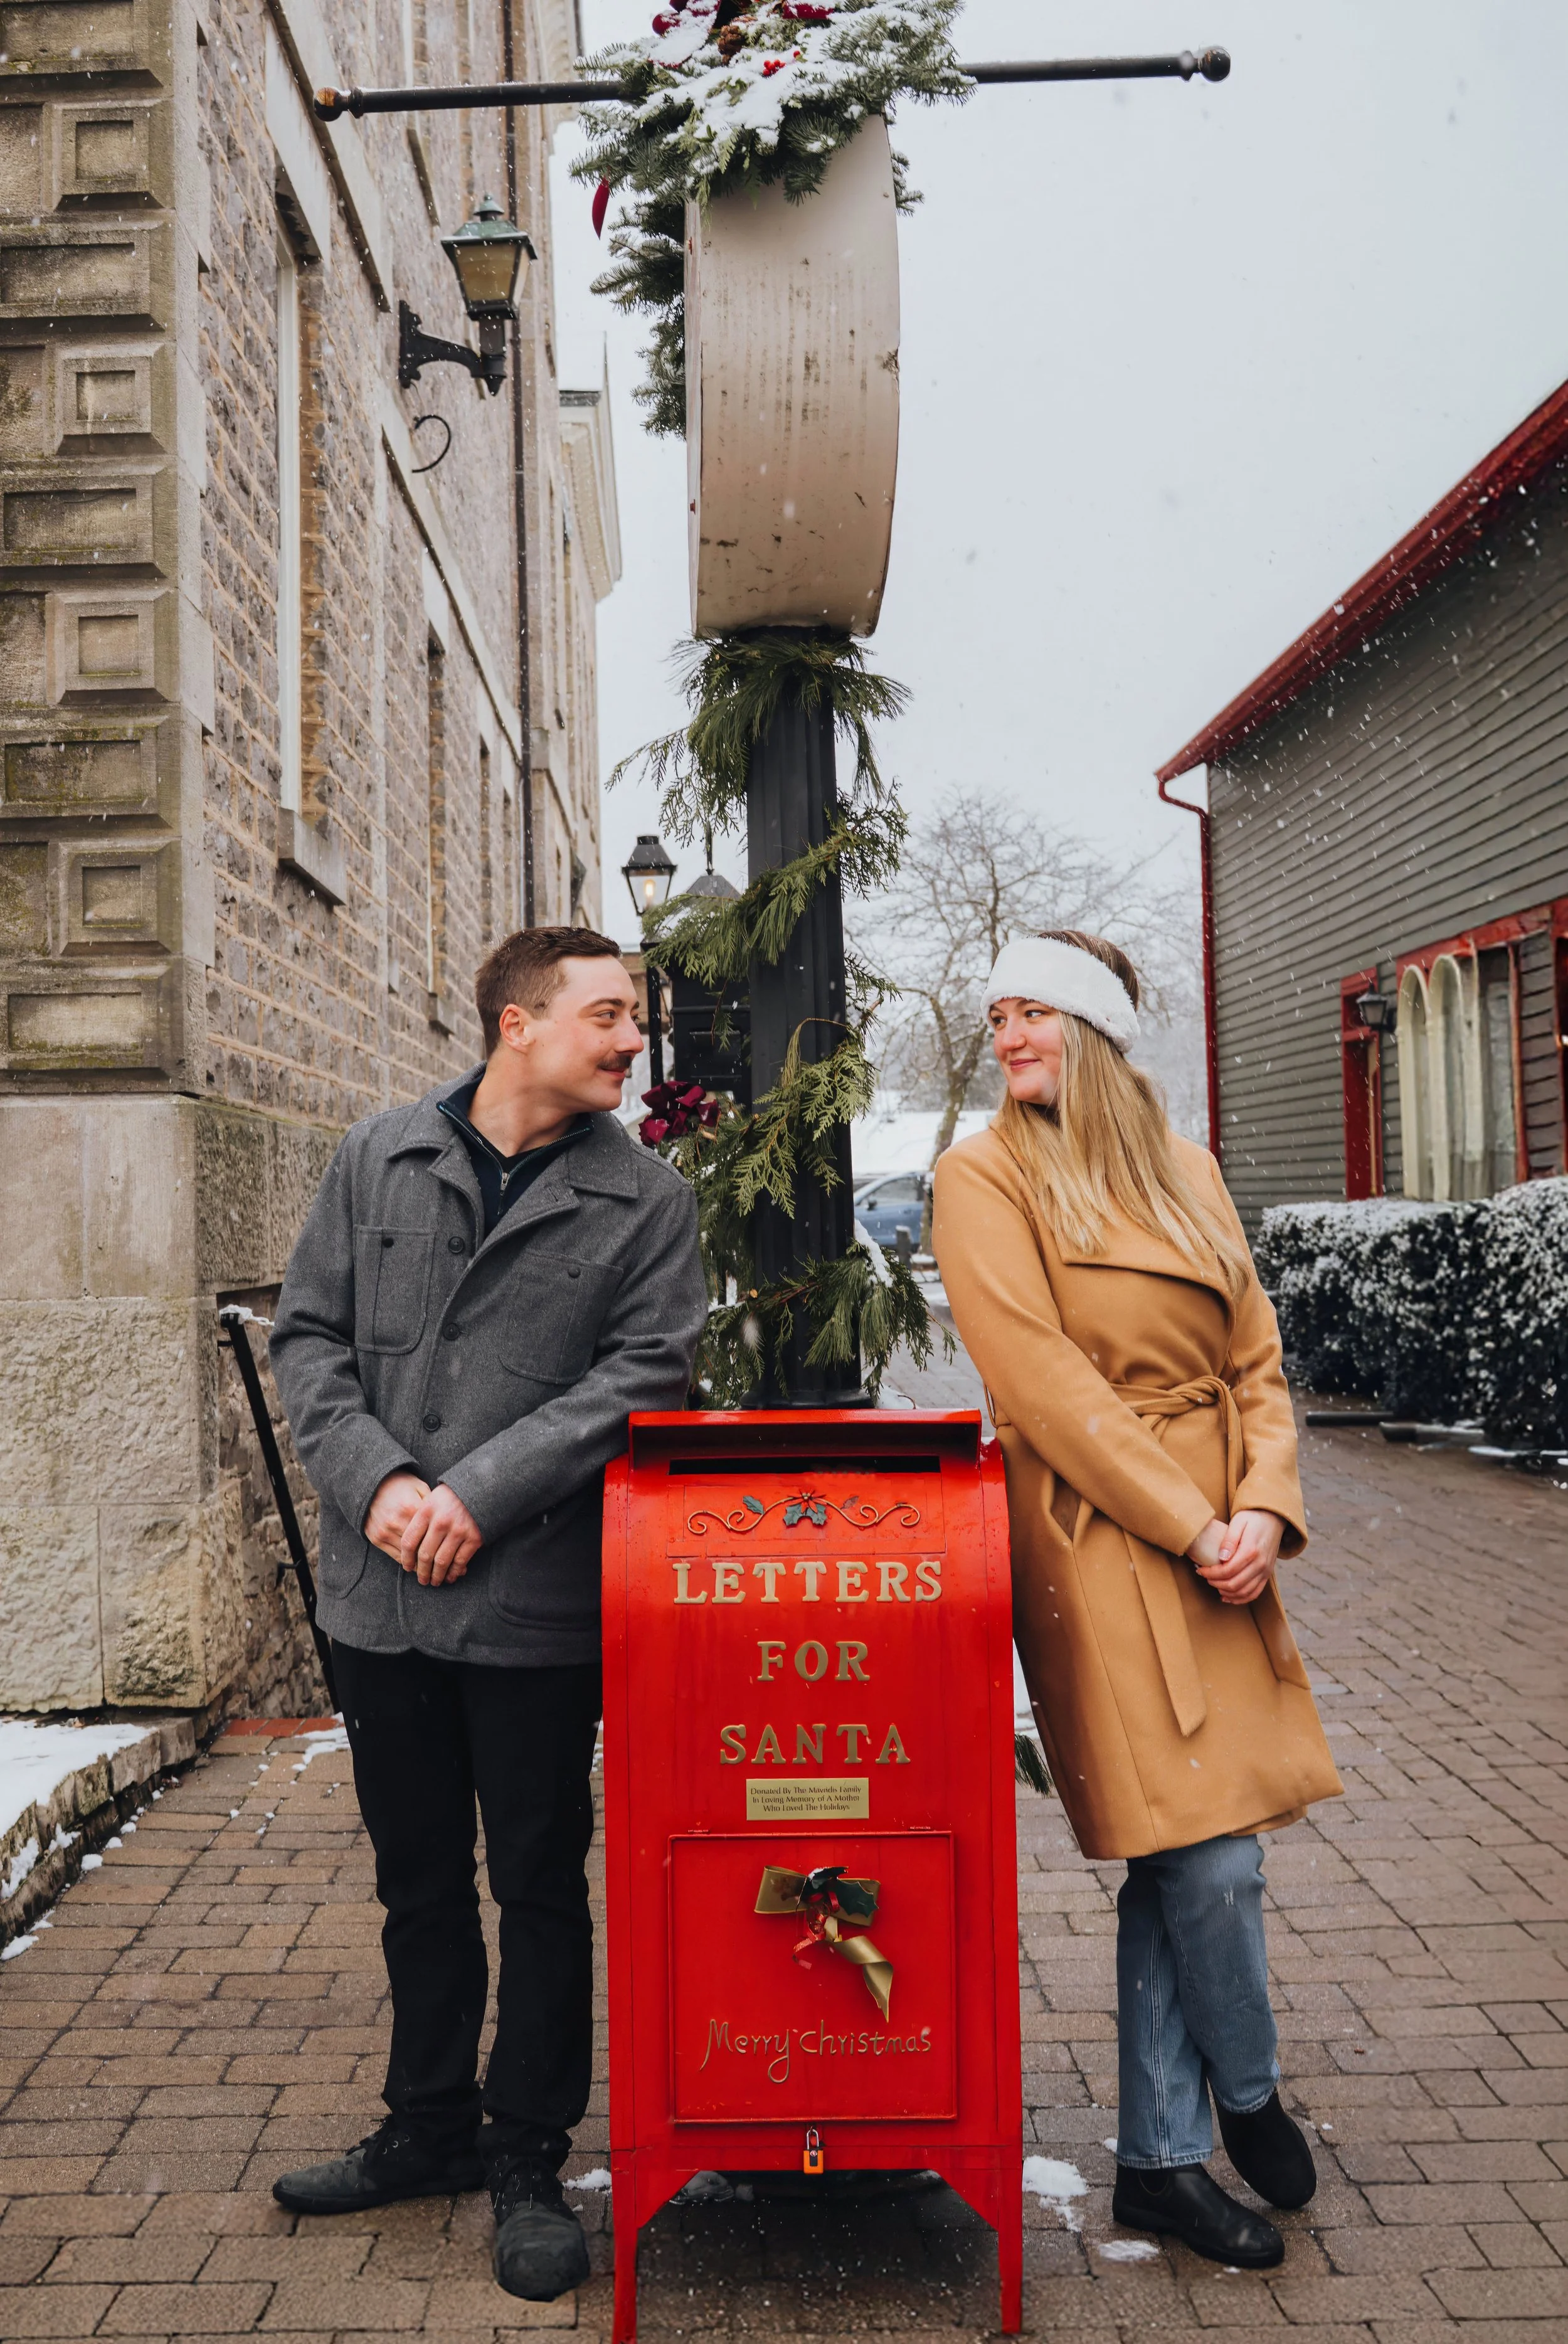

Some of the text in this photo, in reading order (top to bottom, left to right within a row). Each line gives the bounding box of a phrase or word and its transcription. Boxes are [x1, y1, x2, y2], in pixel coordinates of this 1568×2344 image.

[672, 1561, 942, 1604] LETTERS
[757, 1640, 871, 1682] FOR
[720, 1724, 911, 1764] SANTA
[820, 1803, 850, 1811] Holidays
[840, 1785, 861, 1793] Family
[699, 2019, 791, 2084] Merry
